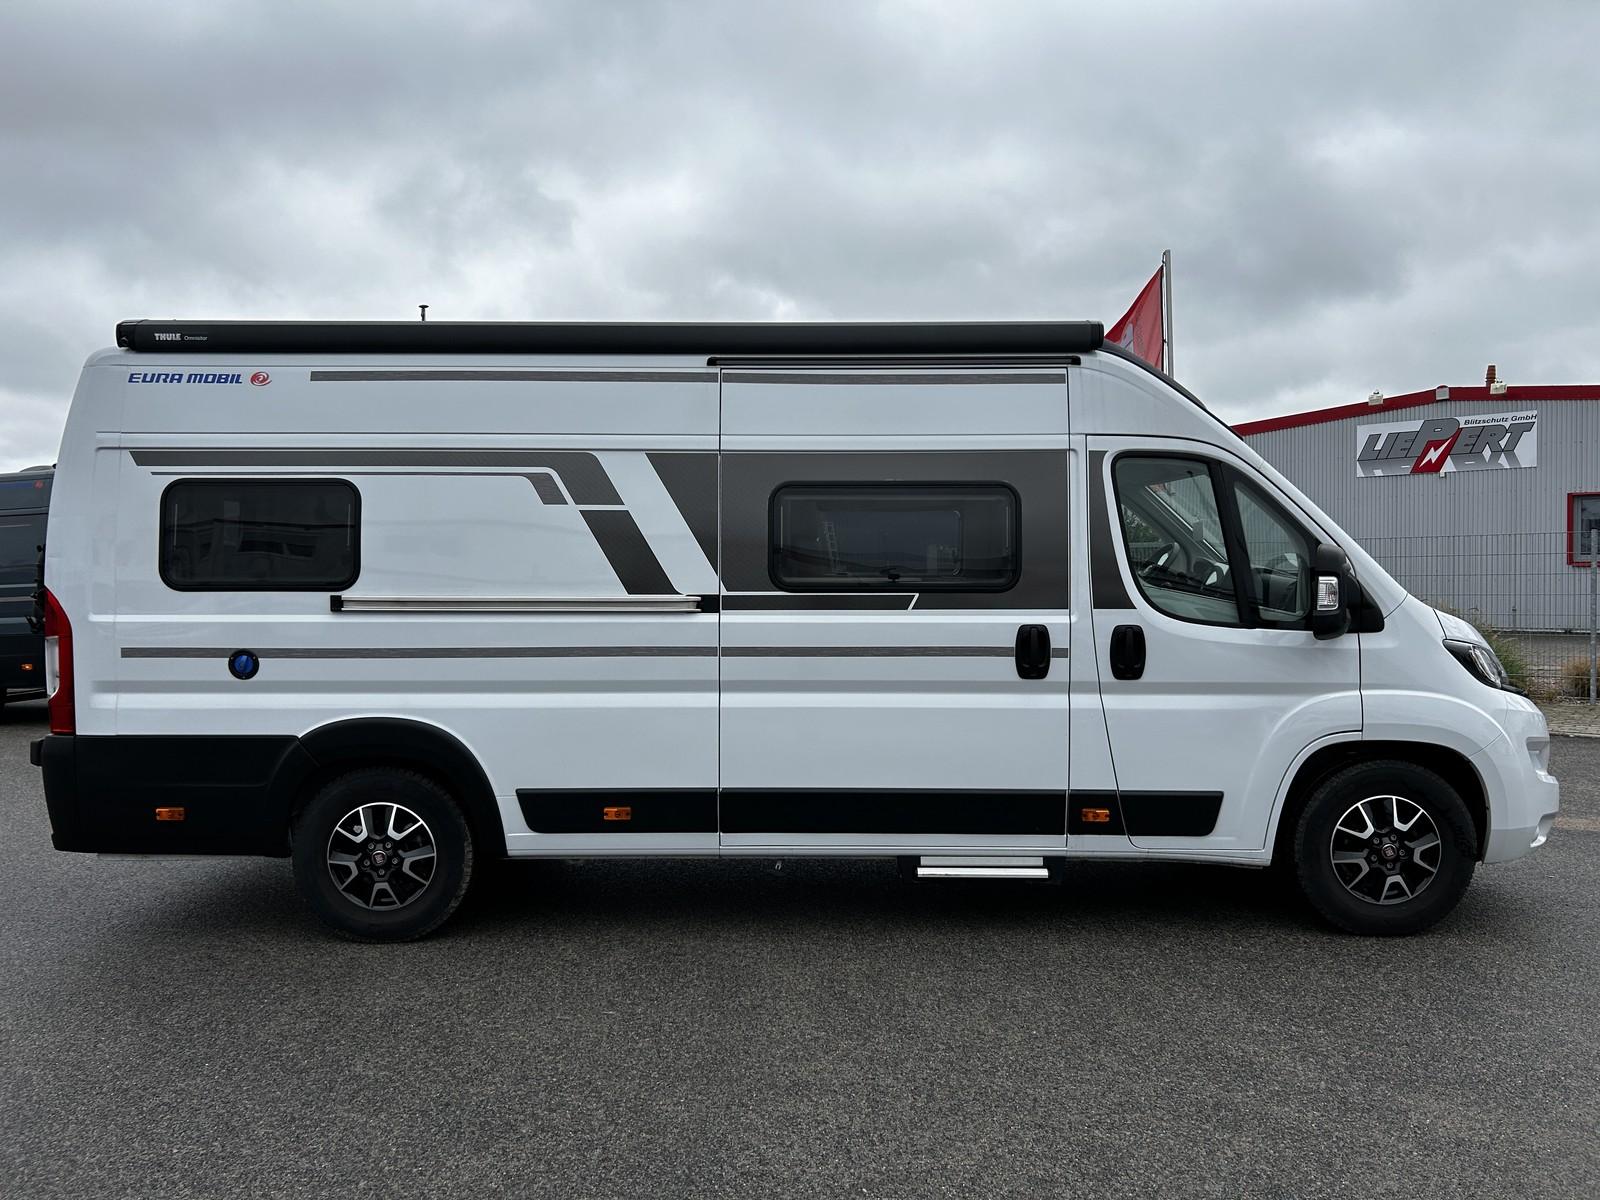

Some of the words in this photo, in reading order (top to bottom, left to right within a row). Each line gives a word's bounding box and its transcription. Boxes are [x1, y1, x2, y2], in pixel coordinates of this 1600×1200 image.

[154, 333, 181, 341] THULE
[128, 373, 184, 384] EURA
[186, 373, 243, 384] MOBIL
[1464, 417, 1509, 426] Blitzschutz
[1511, 414, 1538, 422] GmbH
[1357, 417, 1536, 473] LIEPERT
